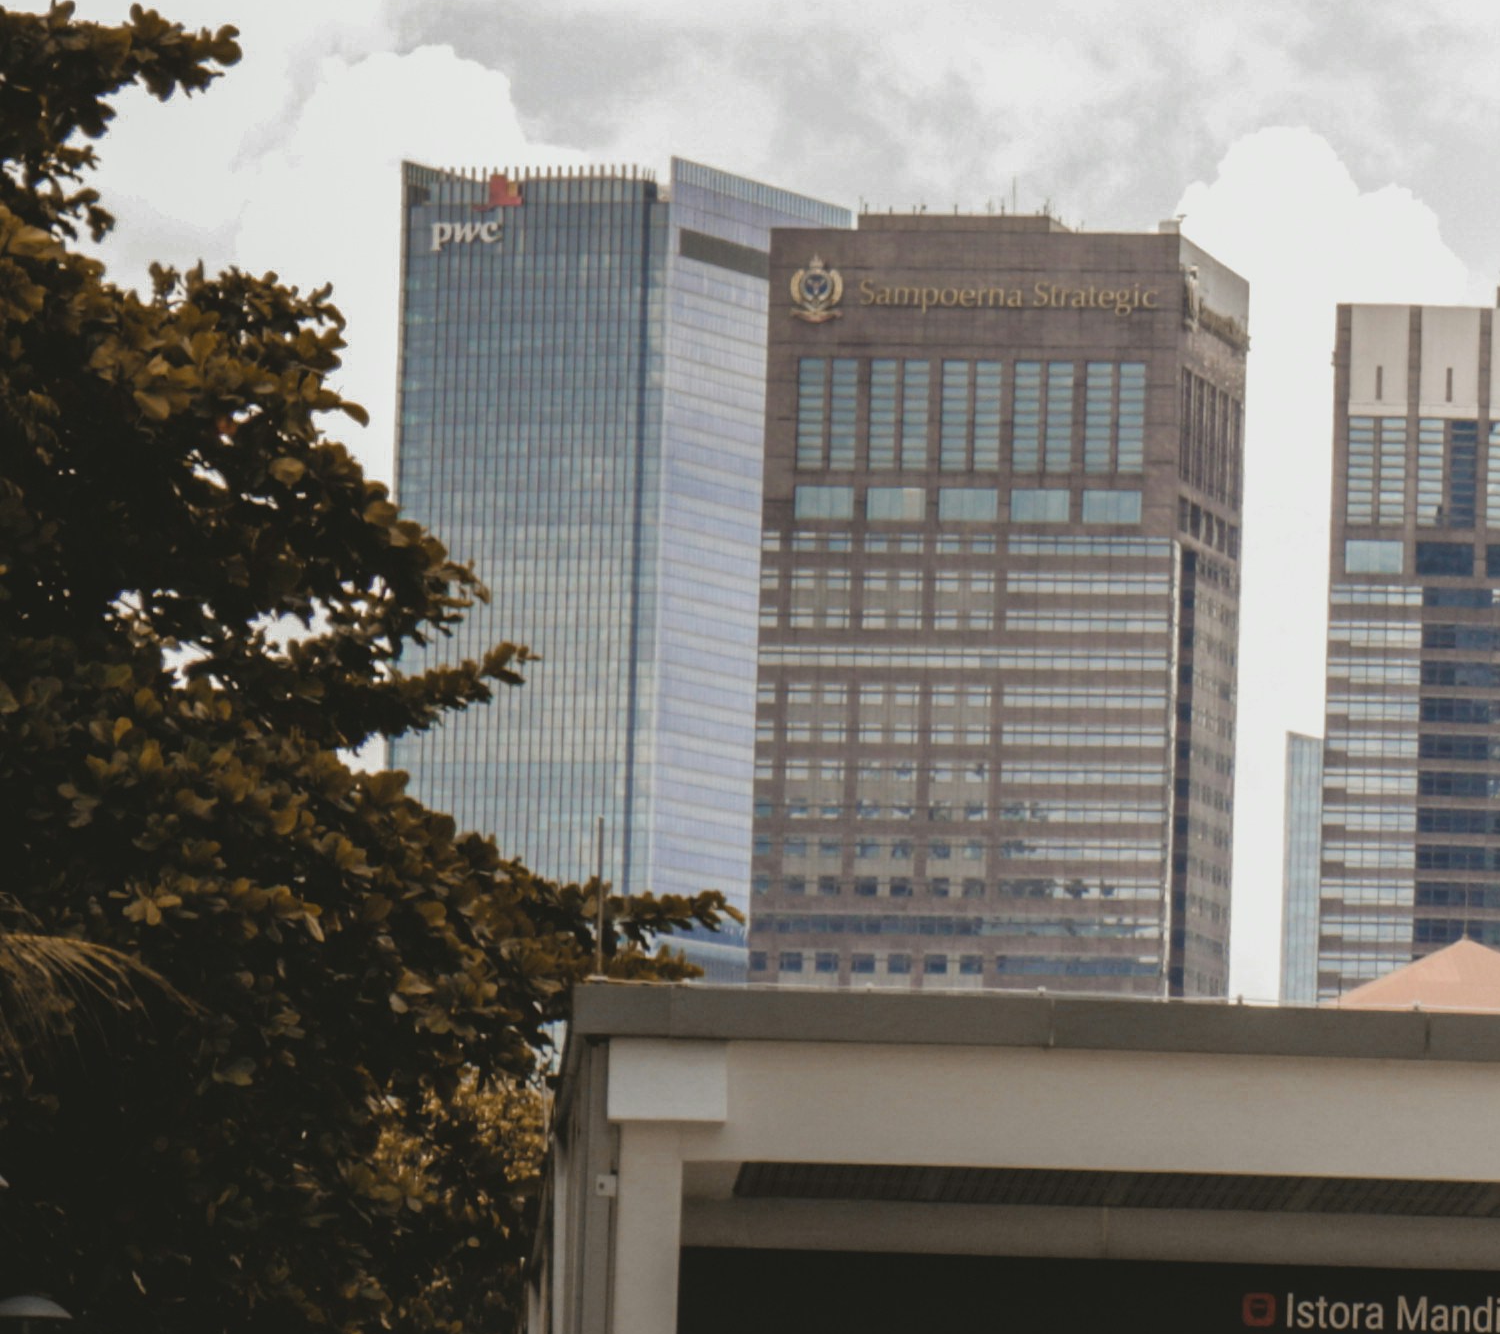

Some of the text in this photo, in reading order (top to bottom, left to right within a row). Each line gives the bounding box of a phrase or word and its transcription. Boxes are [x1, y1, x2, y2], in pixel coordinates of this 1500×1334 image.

[430, 221, 503, 251] pwc
[859, 273, 1160, 315] Sampoerna Strategic
[1286, 1292, 1384, 1330] Istora
